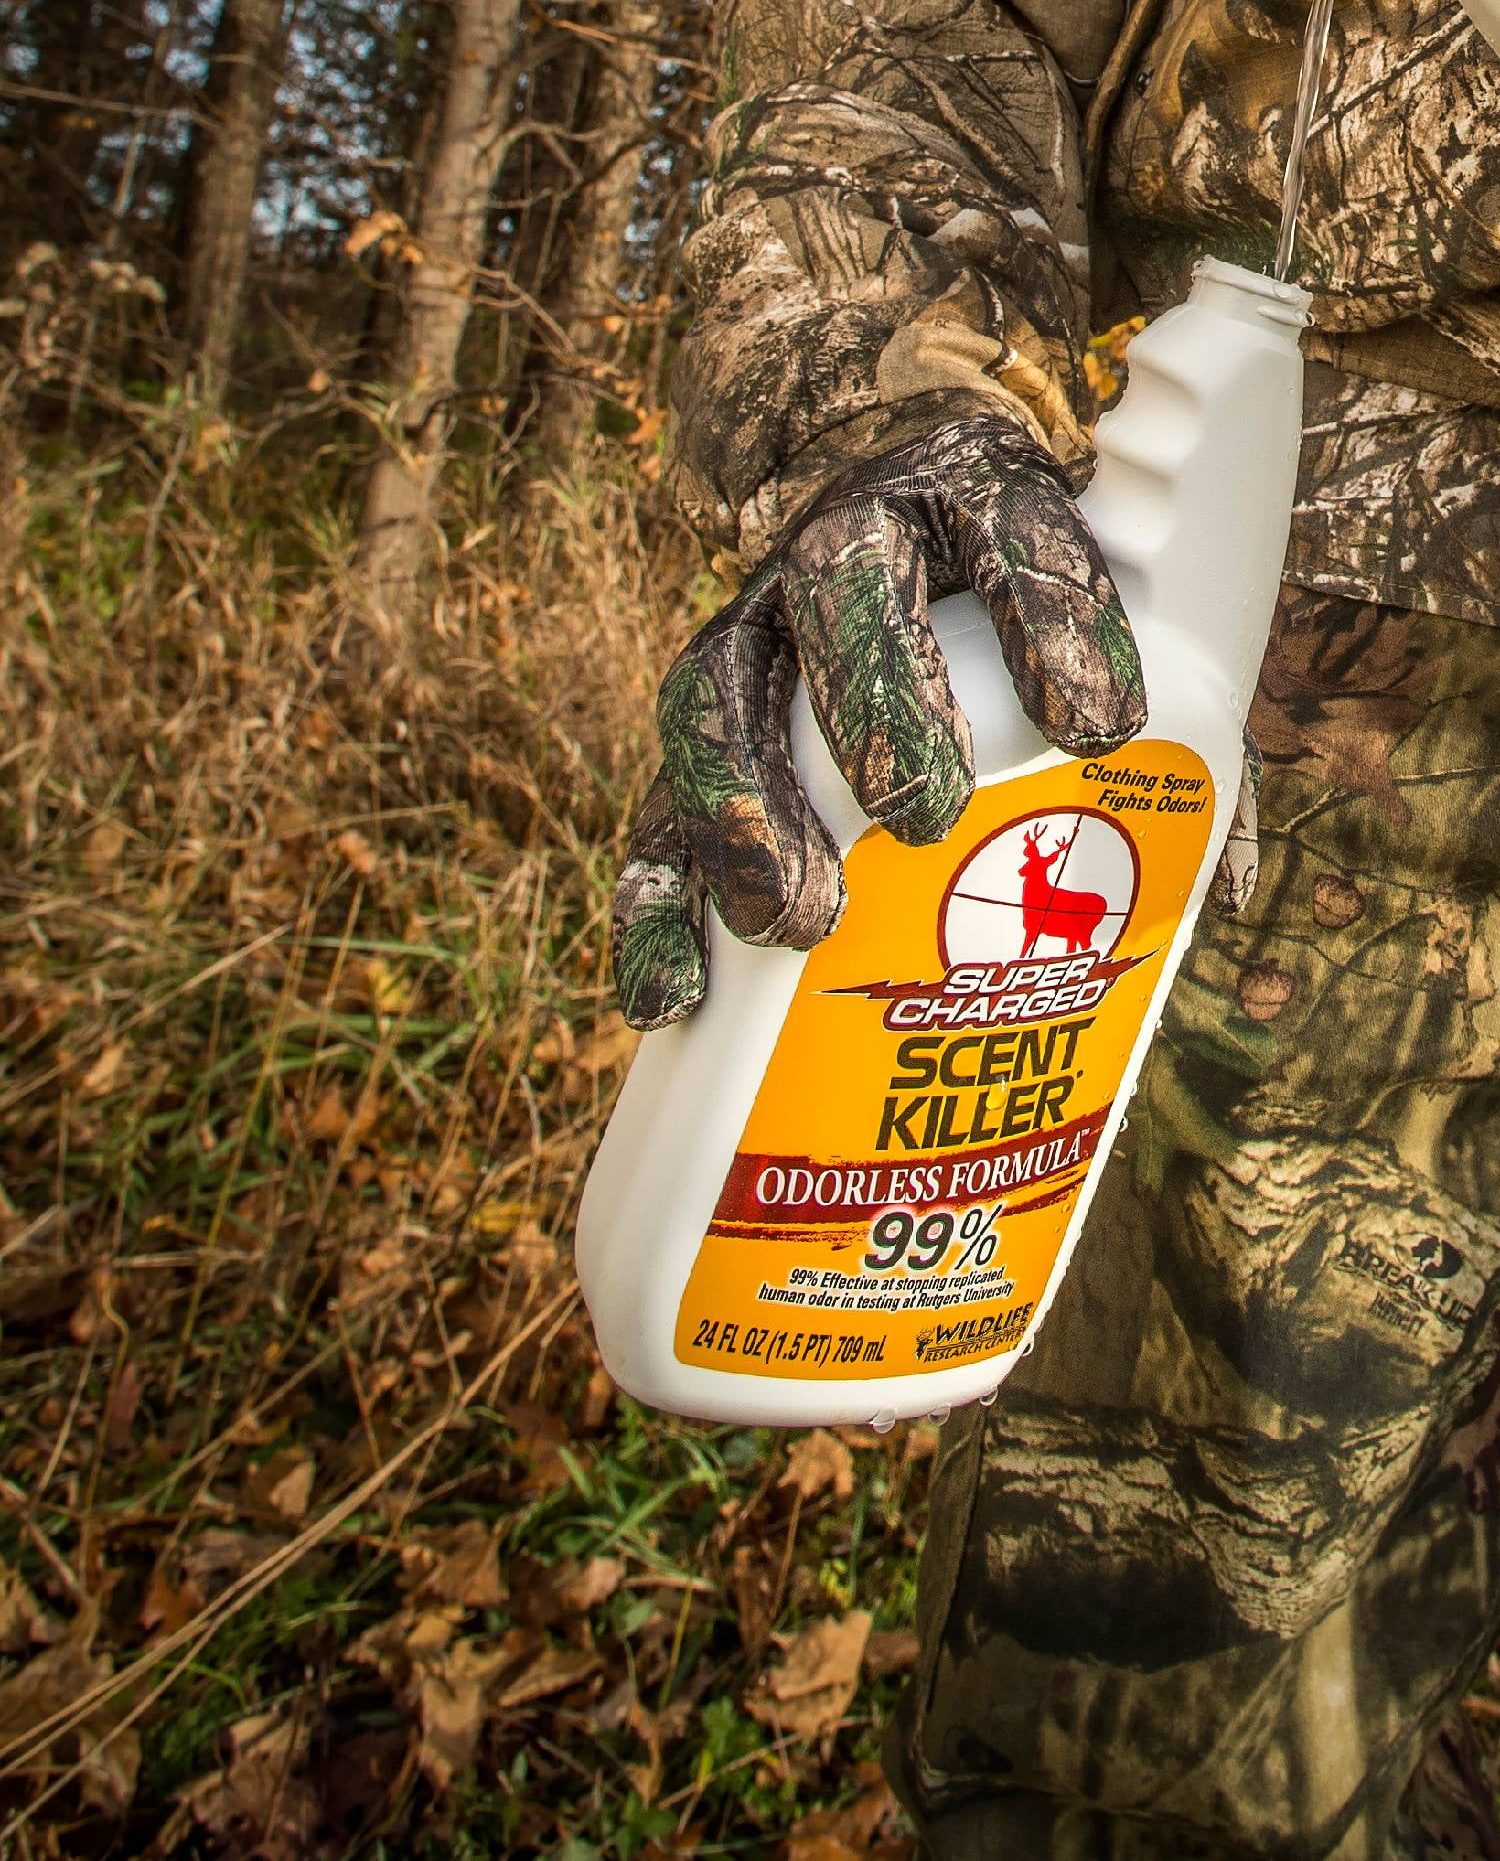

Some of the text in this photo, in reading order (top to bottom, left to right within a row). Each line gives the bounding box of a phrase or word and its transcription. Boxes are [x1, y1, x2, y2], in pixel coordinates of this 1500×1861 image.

[1081, 762, 1206, 796] Clothing Spray
[1097, 788, 1208, 814] Fights Odors!
[943, 961, 1095, 995] SUPER
[889, 980, 1105, 1027] CHARGED
[889, 1016, 1098, 1089] SCENT
[875, 1074, 1077, 1152] KILLER
[756, 1136, 1083, 1207] ODORLESS FORMULA
[864, 1205, 1001, 1271] 99%
[758, 1280, 1015, 1312] human odor in testing at Rutgers University
[789, 1266, 1005, 1295] 99% Effective at stopping replicated
[692, 1318, 888, 1369] 24 FL OZ (1.5 PT) 709 mL
[935, 1301, 1034, 1345] WILDLIFE
[923, 1342, 983, 1363] RESEARCH
